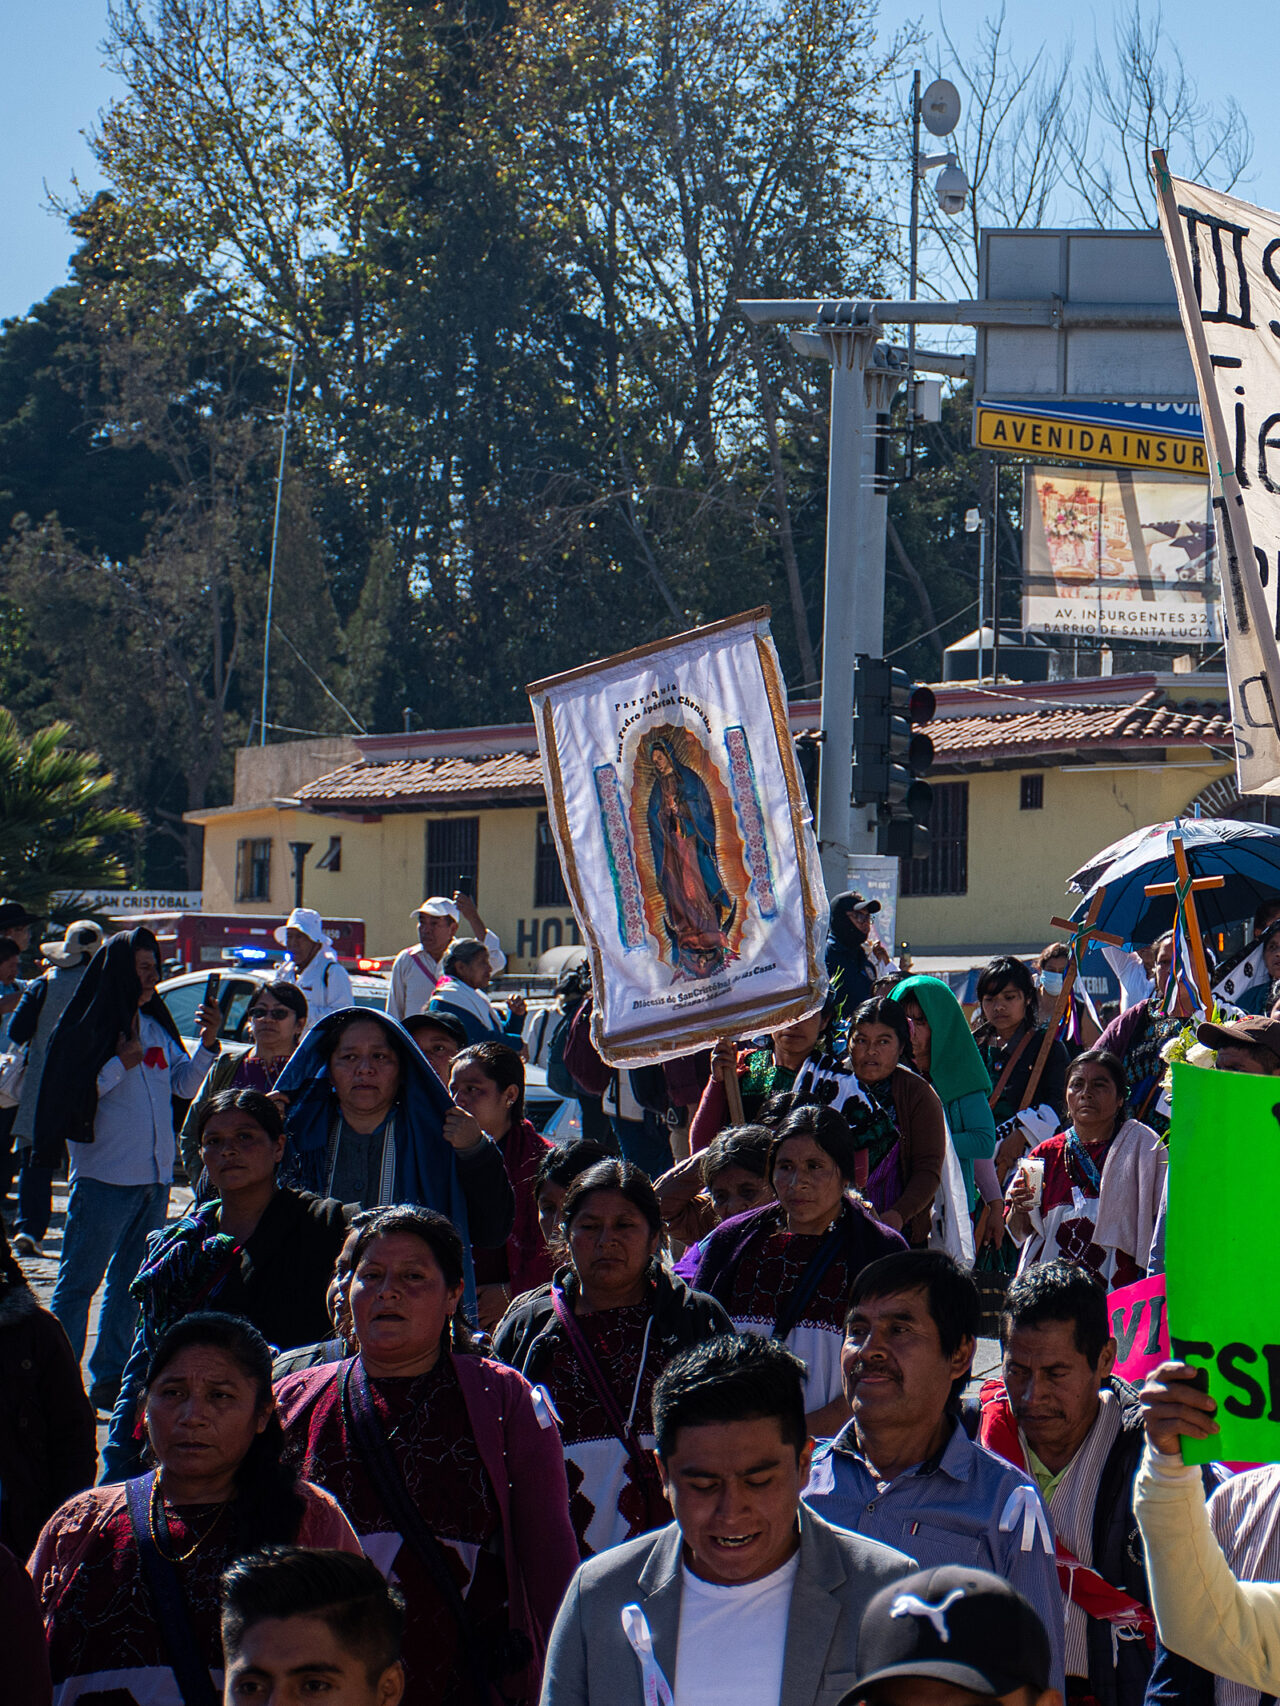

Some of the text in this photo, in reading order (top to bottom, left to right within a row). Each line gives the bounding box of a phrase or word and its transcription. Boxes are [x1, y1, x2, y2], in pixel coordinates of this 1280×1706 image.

[1178, 204, 1255, 330] III
[993, 420, 1117, 456] AVENIDA
[1055, 609, 1077, 620] AV.
[1082, 610, 1185, 622] INSURGENTES
[1044, 623, 1096, 634] BARRIO
[1101, 625, 1117, 635] DE
[1122, 625, 1166, 636] SANTA
[123, 895, 189, 908] CRISTÓBAL
